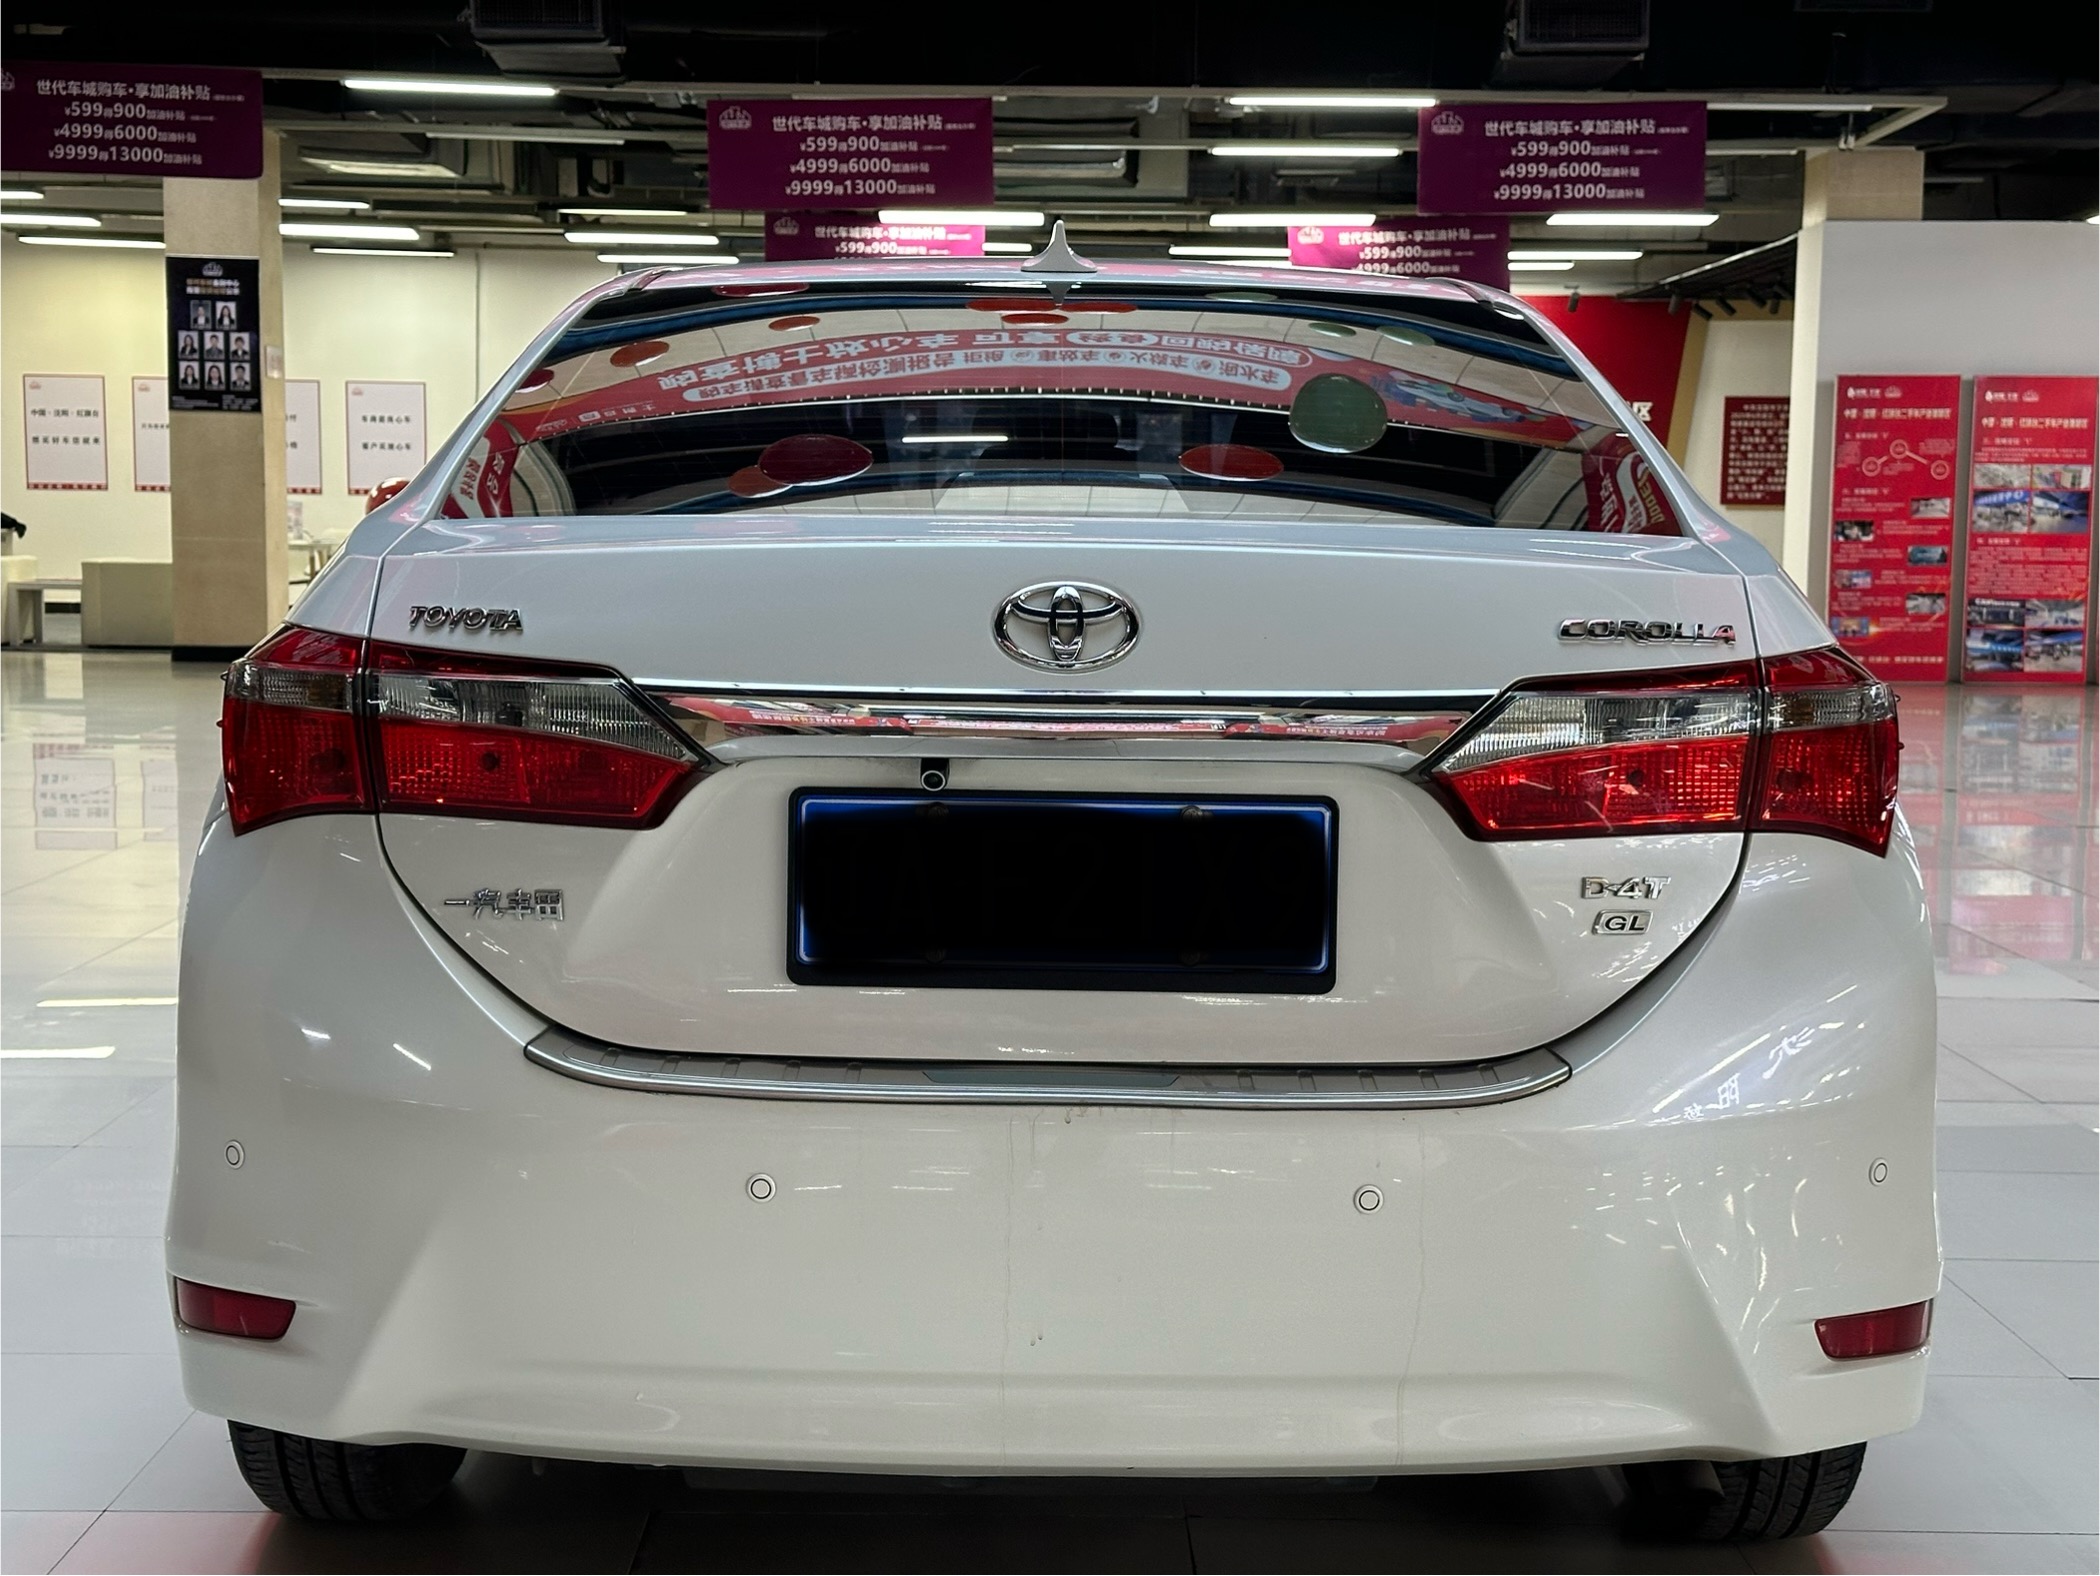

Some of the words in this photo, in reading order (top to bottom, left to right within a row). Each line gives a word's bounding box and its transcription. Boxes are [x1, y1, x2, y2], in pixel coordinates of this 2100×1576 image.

[409, 605, 524, 632] TOYOTA
[1557, 618, 1737, 648] COROLLA
[1580, 876, 1672, 899] D-4T
[443, 888, 564, 921] 一汽丰田
[1604, 915, 1646, 931] GL
